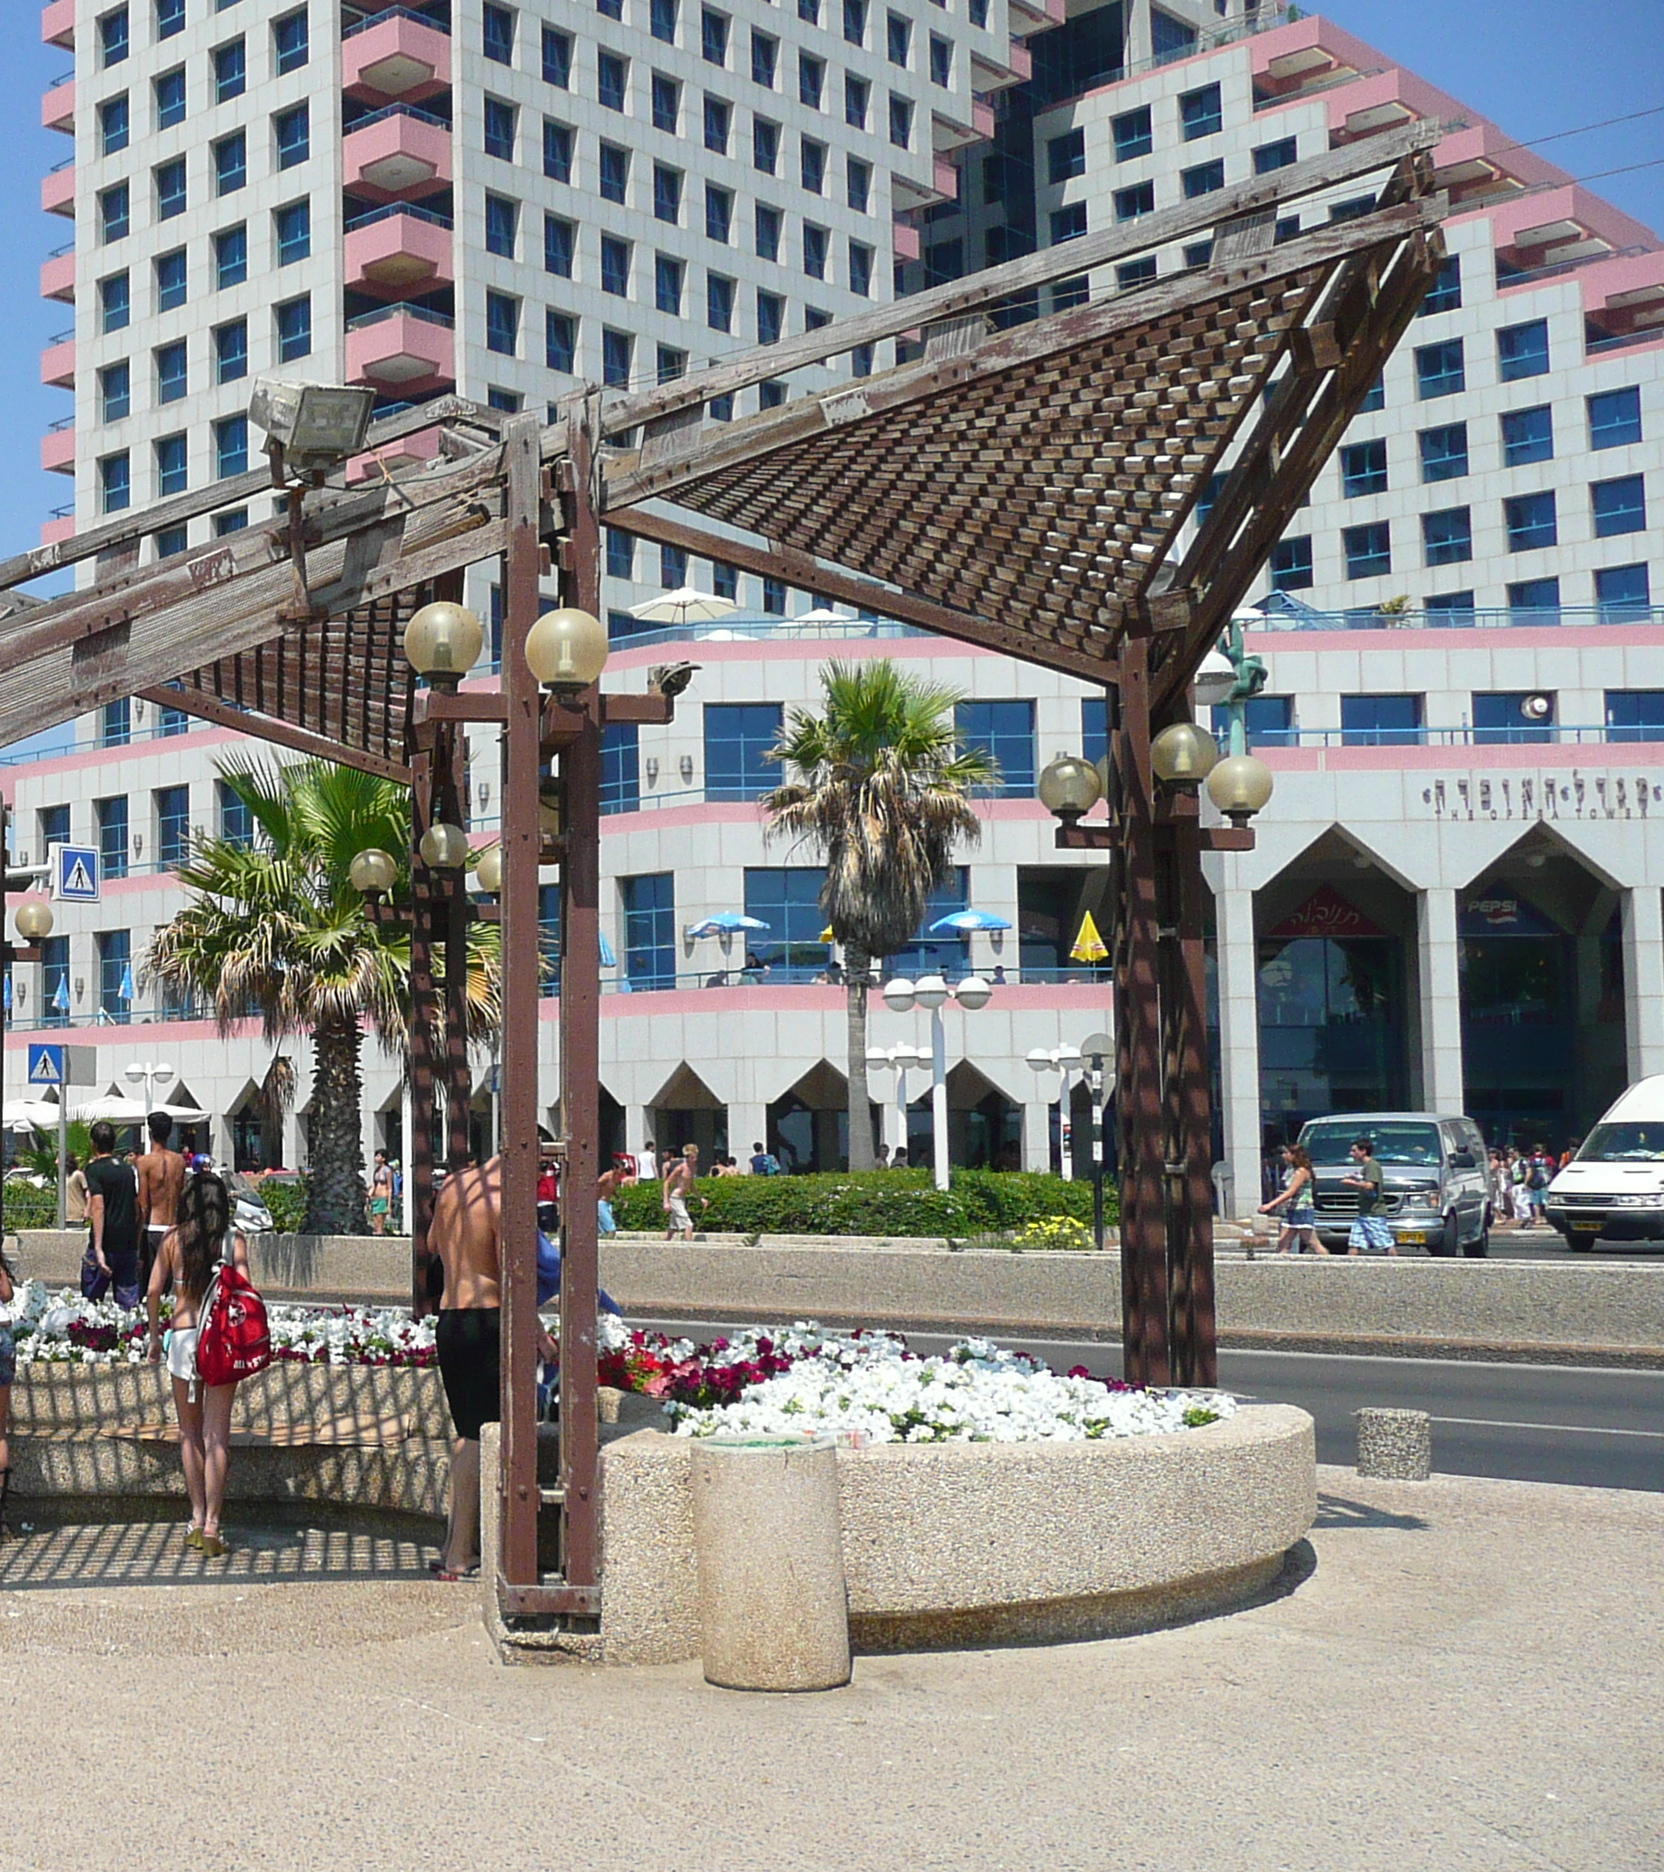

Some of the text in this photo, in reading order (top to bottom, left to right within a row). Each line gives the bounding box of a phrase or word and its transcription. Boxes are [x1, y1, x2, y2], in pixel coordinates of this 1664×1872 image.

[1435, 808, 1648, 821] THE OPERA TOWER
[1468, 901, 1517, 912] PEPSI
